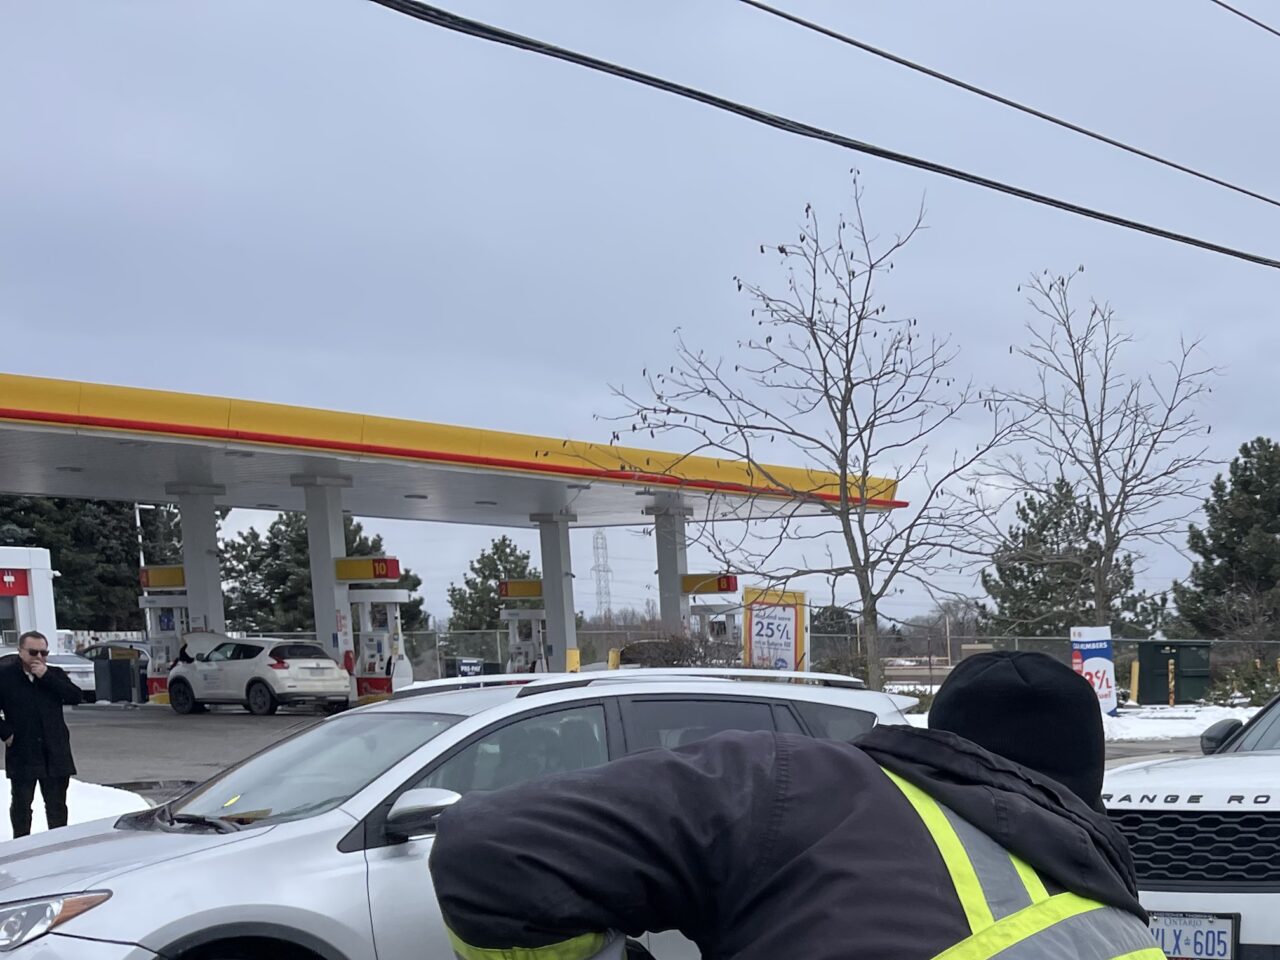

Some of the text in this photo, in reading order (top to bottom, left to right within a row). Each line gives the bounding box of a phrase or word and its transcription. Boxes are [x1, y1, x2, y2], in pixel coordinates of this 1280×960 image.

[374, 562, 387, 576] 10
[720, 578, 727, 589] 8
[1097, 692, 1112, 700] uel
[1102, 794, 1204, 804] RANGE
[1194, 929, 1227, 957] 605
